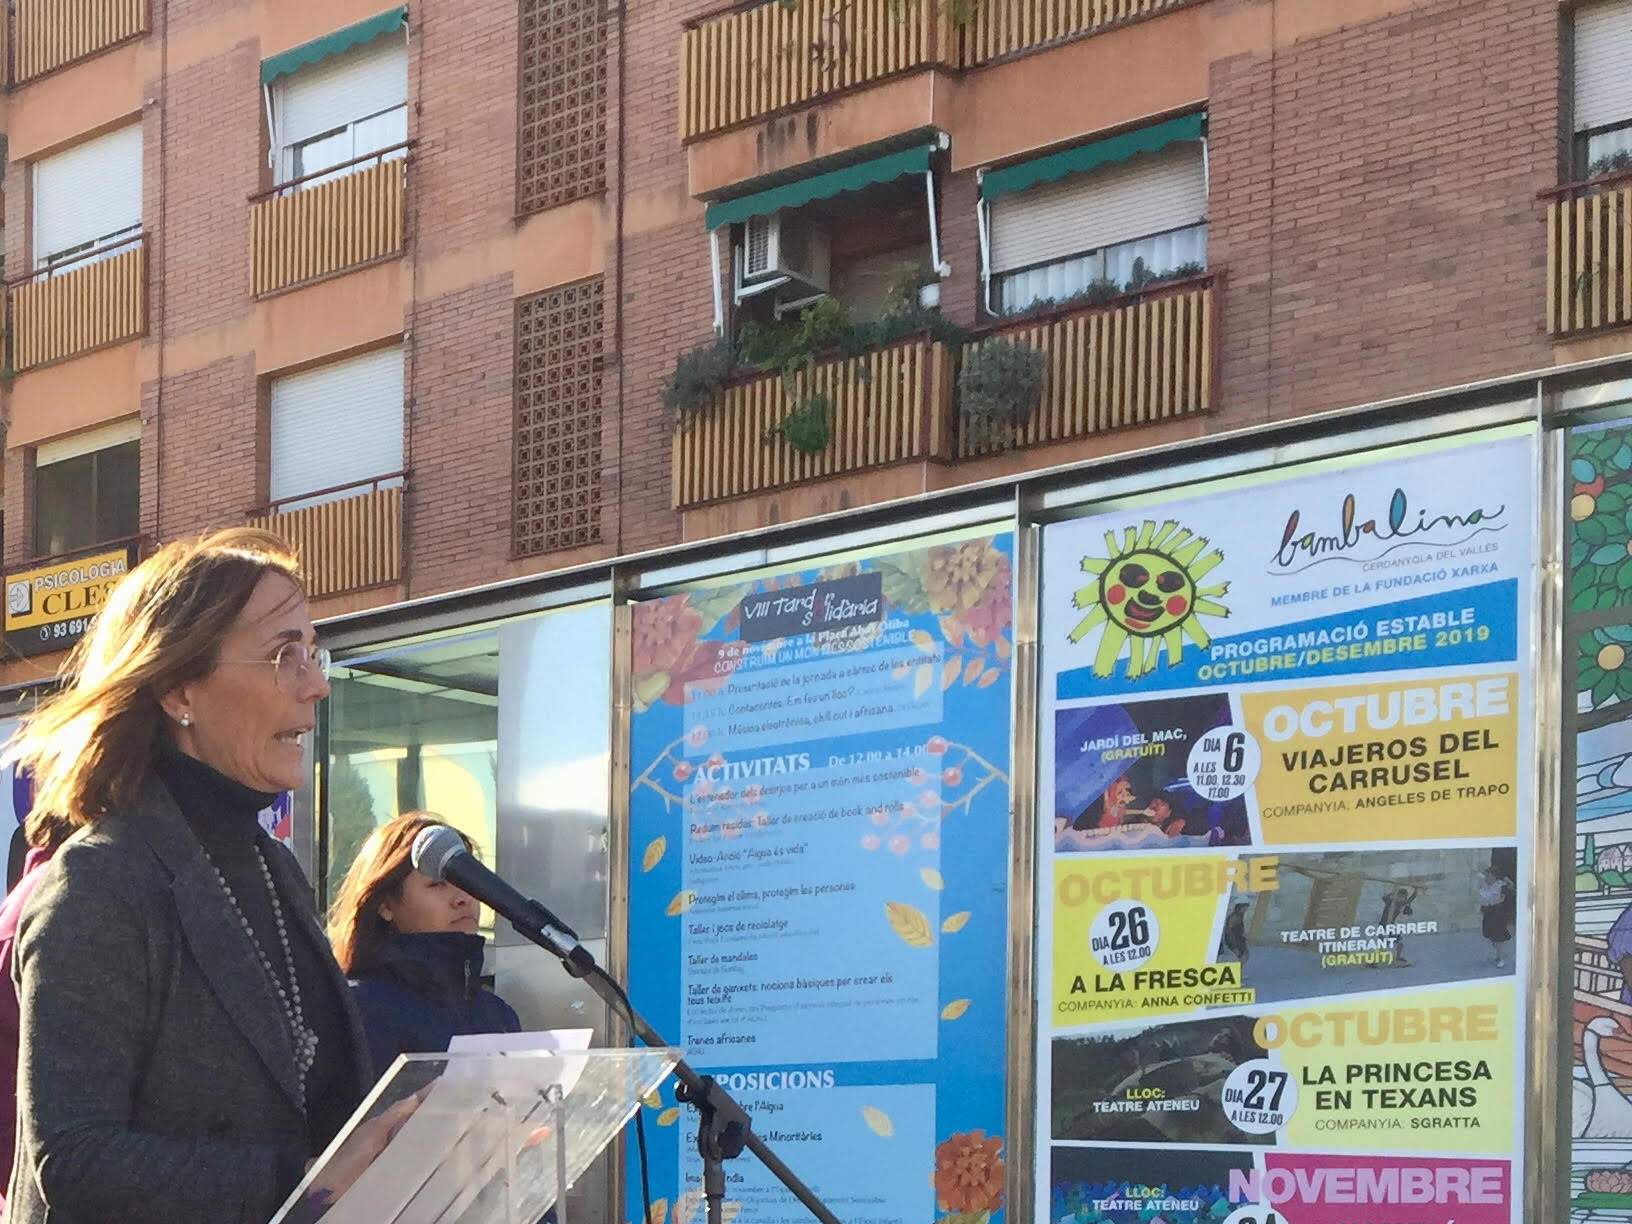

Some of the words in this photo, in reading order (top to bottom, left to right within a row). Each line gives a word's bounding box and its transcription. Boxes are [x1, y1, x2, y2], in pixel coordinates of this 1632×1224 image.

[1270, 488, 1505, 566] bambalina
[1436, 550, 1456, 560] DEL
[1271, 589, 1328, 607] MEMBRE
[1333, 585, 1350, 597] DE
[1354, 581, 1371, 593] LA
[1375, 568, 1447, 590] FUNDACIÓ
[1451, 561, 1498, 578] XARXA
[1210, 621, 1368, 661] PROGRAMACIÓ
[1376, 607, 1475, 637] ESTABLE
[1197, 633, 1427, 680] OCTUBRE/DESEMBRE
[1435, 625, 1490, 648] 2019
[1263, 678, 1509, 742] OCTUBRE
[1080, 735, 1119, 752] JARDÍ
[1123, 732, 1148, 747] DEL
[1203, 738, 1221, 753] DIA
[1223, 732, 1246, 773] 6
[1281, 735, 1428, 772] VIAJEROS
[1439, 729, 1499, 754] DEL
[694, 753, 810, 784] ACTIVITATS
[1201, 761, 1217, 773] LES
[1308, 758, 1470, 794] CARRUSEL
[1354, 792, 1425, 810] ANGELES
[1430, 789, 1450, 802] DE
[1457, 783, 1510, 799] TRAPO
[1059, 856, 1279, 907] OCTUBRE
[1092, 938, 1110, 952] DIA
[1108, 907, 1150, 950] 26
[1281, 931, 1335, 943] TEATRE
[1340, 926, 1360, 938] DE
[1110, 951, 1126, 964] LES
[1128, 946, 1151, 960] 12.00
[1319, 938, 1397, 953] ITINERANT
[1070, 976, 1086, 994] A
[1095, 973, 1125, 992] LA
[1134, 966, 1235, 990] FRESCA
[1141, 996, 1179, 1008] ANNA
[1183, 992, 1251, 1005] CONFETTI
[1253, 1004, 1498, 1050] OCTUBRE
[713, 1070, 835, 1091] POSICIONS
[1302, 1065, 1336, 1085] LA
[1346, 1060, 1492, 1084] PRINCESA
[1126, 1088, 1166, 1100] LLOC:
[1225, 1089, 1243, 1103] DIA
[1243, 1069, 1288, 1111] 27
[1316, 1090, 1352, 1110] EN
[1362, 1087, 1477, 1109] TEXANS
[1093, 1102, 1143, 1113] TEATRE
[1147, 1100, 1200, 1111] ATENEU
[1239, 1111, 1256, 1123] LES
[1258, 1113, 1283, 1125] 12.00
[1411, 1117, 1480, 1129] SGRATTA
[1125, 1187, 1165, 1198] LLOC:
[1229, 1167, 1503, 1204] NOVEMBRE
[1093, 1200, 1143, 1211] TEATRE
[1146, 1200, 1199, 1211] ATENEU
